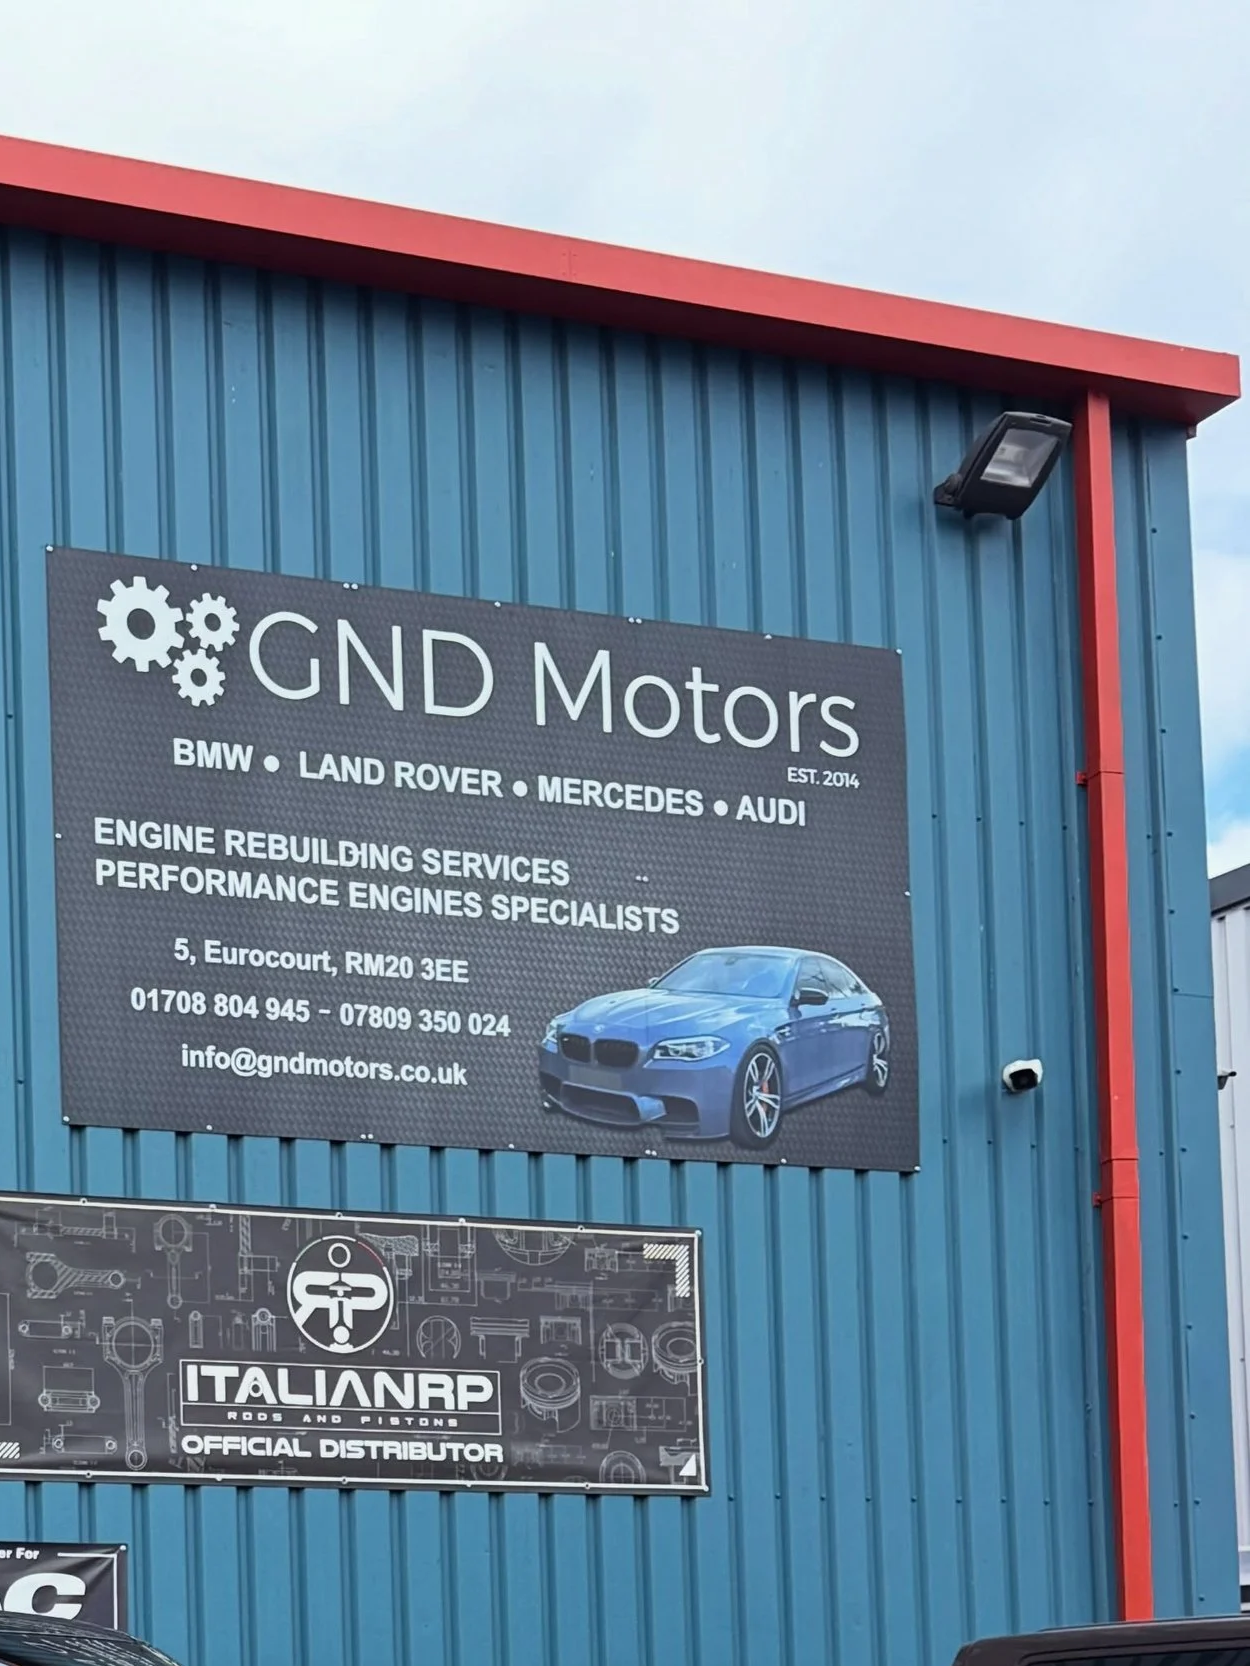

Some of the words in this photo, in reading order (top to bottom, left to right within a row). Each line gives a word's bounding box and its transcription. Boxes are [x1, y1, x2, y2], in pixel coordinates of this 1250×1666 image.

[248, 610, 494, 717] GND
[533, 641, 860, 758] Motors
[172, 737, 254, 773] BMW
[299, 750, 386, 786] LAND
[393, 760, 504, 798] ROVER
[537, 774, 704, 817] MERCEDES
[735, 794, 806, 827] AUDI
[787, 766, 820, 785] EST.
[822, 770, 861, 789] 2014
[94, 816, 216, 855] ENGINE
[224, 828, 414, 873] REBUILDING
[421, 847, 571, 887] SERVICES
[95, 857, 340, 907] PERFORMANCE
[348, 880, 484, 919] ENGINES
[490, 893, 681, 935] SPECIALISTS
[173, 937, 197, 966] 5,
[204, 938, 338, 978] Eurocourt,
[344, 950, 414, 980] RM20
[419, 957, 470, 984] 3EE
[130, 986, 207, 1016] 01708
[213, 992, 260, 1019] 804
[264, 996, 311, 1023] 945
[339, 1002, 412, 1031] 07809
[417, 1008, 462, 1034] 350
[467, 1012, 512, 1038] 024
[181, 1042, 469, 1086] info@gndmotors.co.uk
[186, 1363, 494, 1411] ITALIANRP
[227, 1411, 283, 1422] RODS
[302, 1413, 342, 1424] AND
[360, 1415, 459, 1427] PISTONS
[180, 1434, 313, 1459] OFFICIAL
[319, 1437, 504, 1463] DISTRIBUTOR
[15, 1546, 40, 1560] For
